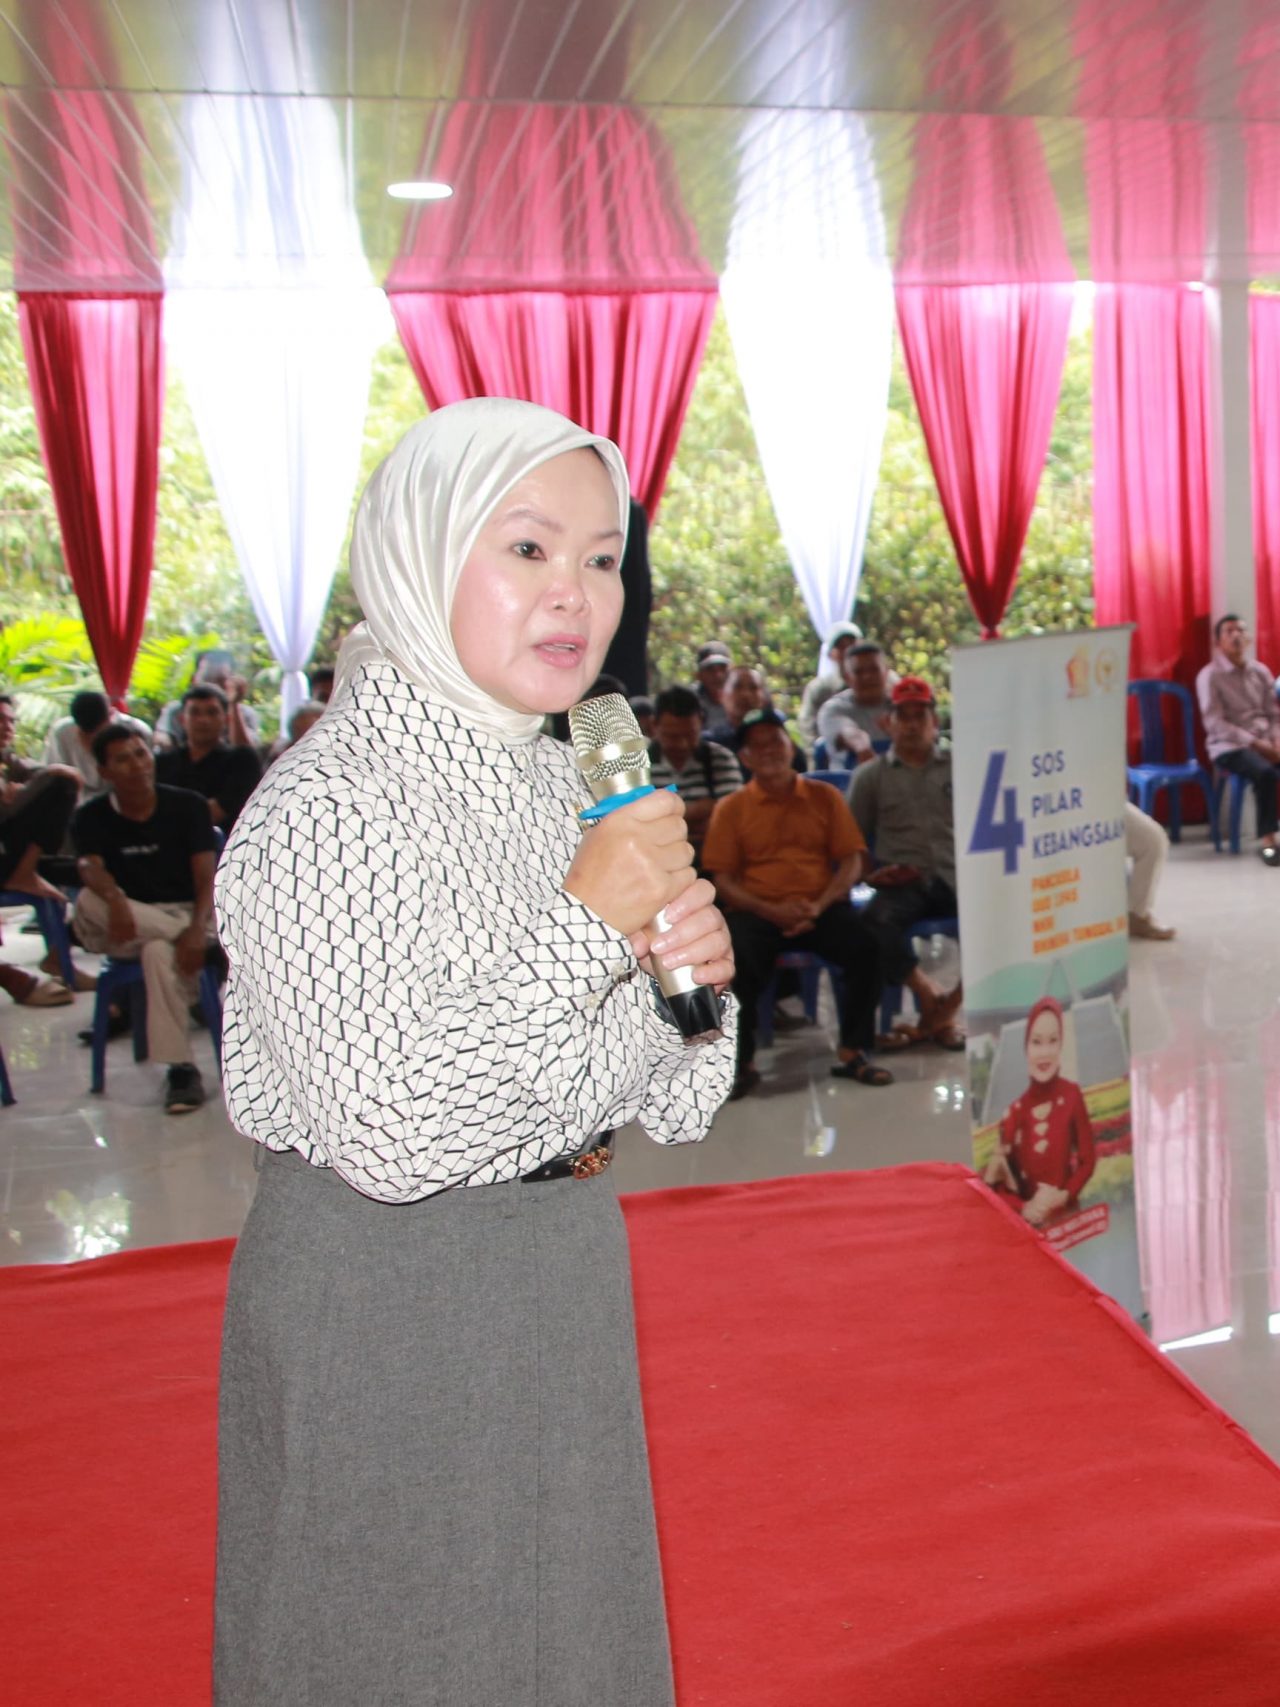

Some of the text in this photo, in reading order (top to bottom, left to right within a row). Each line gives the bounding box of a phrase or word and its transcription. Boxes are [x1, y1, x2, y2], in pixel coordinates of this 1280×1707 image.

[1031, 750, 1065, 777] SOS
[967, 751, 1024, 875] 4
[1031, 787, 1083, 818] PILAR
